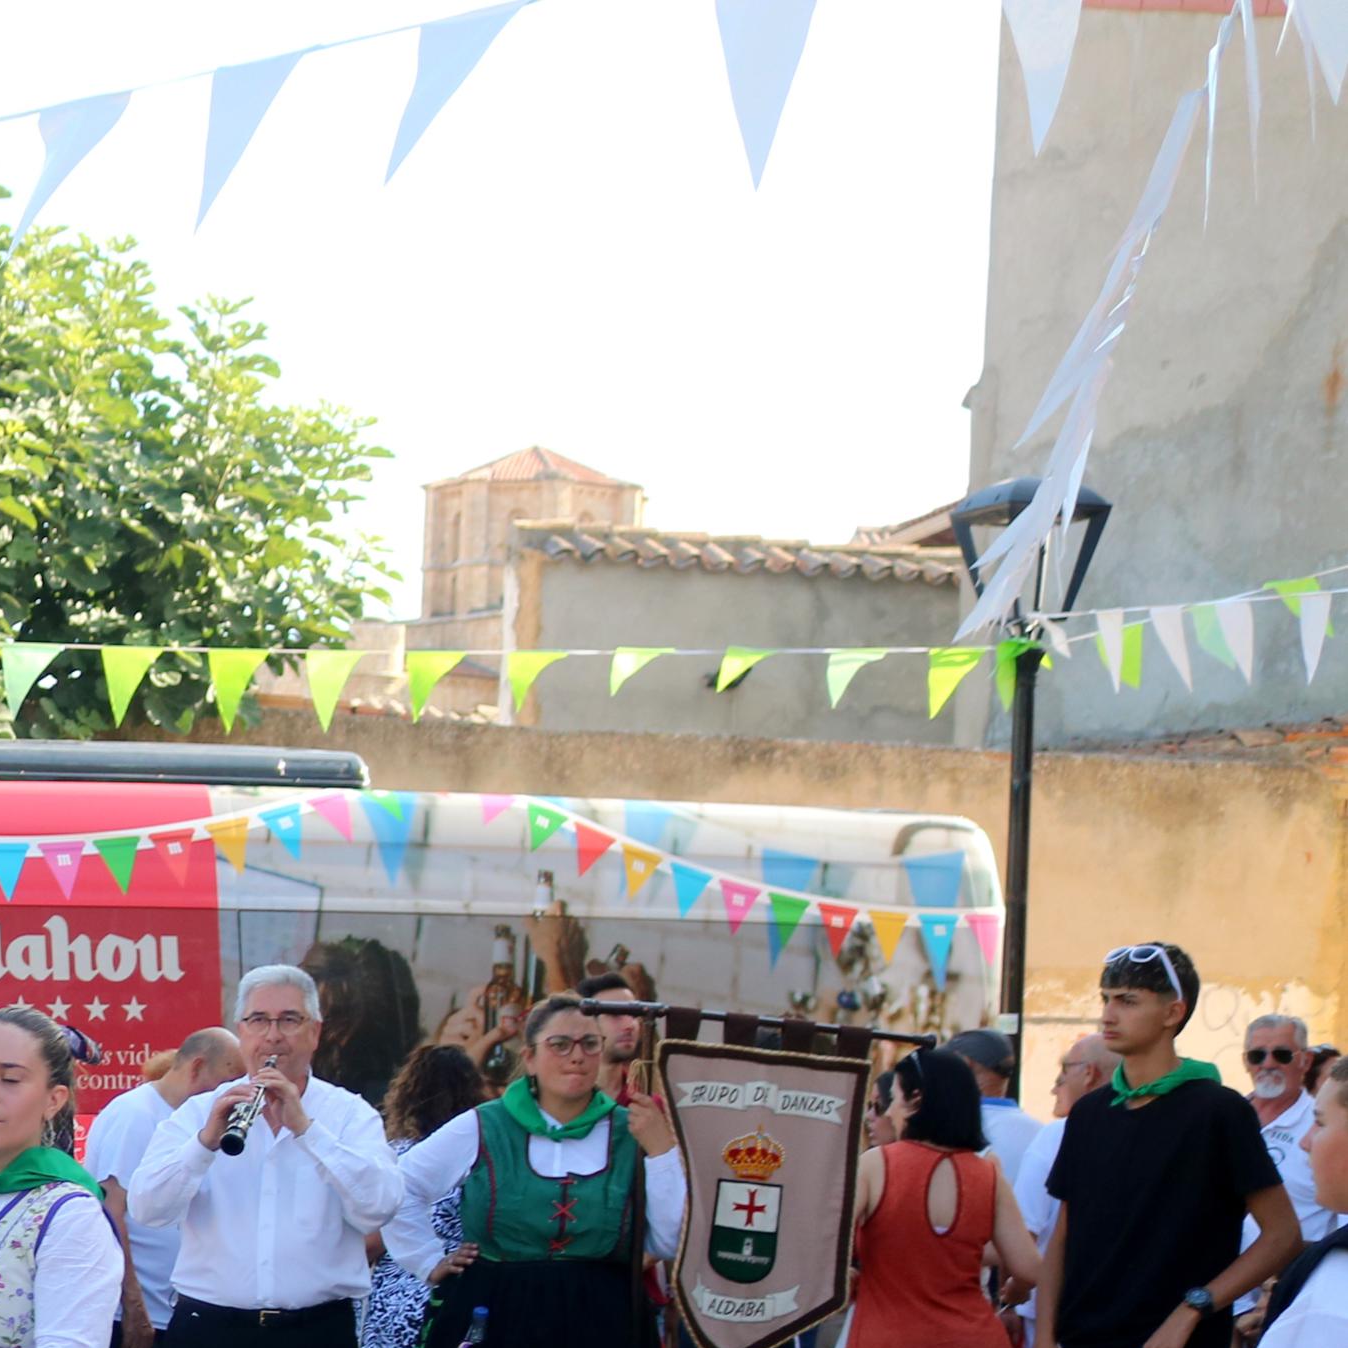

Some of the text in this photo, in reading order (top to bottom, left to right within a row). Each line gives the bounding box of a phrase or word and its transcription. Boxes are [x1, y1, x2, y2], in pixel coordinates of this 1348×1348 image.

[691, 1084, 739, 1104] GRUPO
[781, 1094, 836, 1115] DANZAS
[707, 1298, 766, 1318] ALDABA
